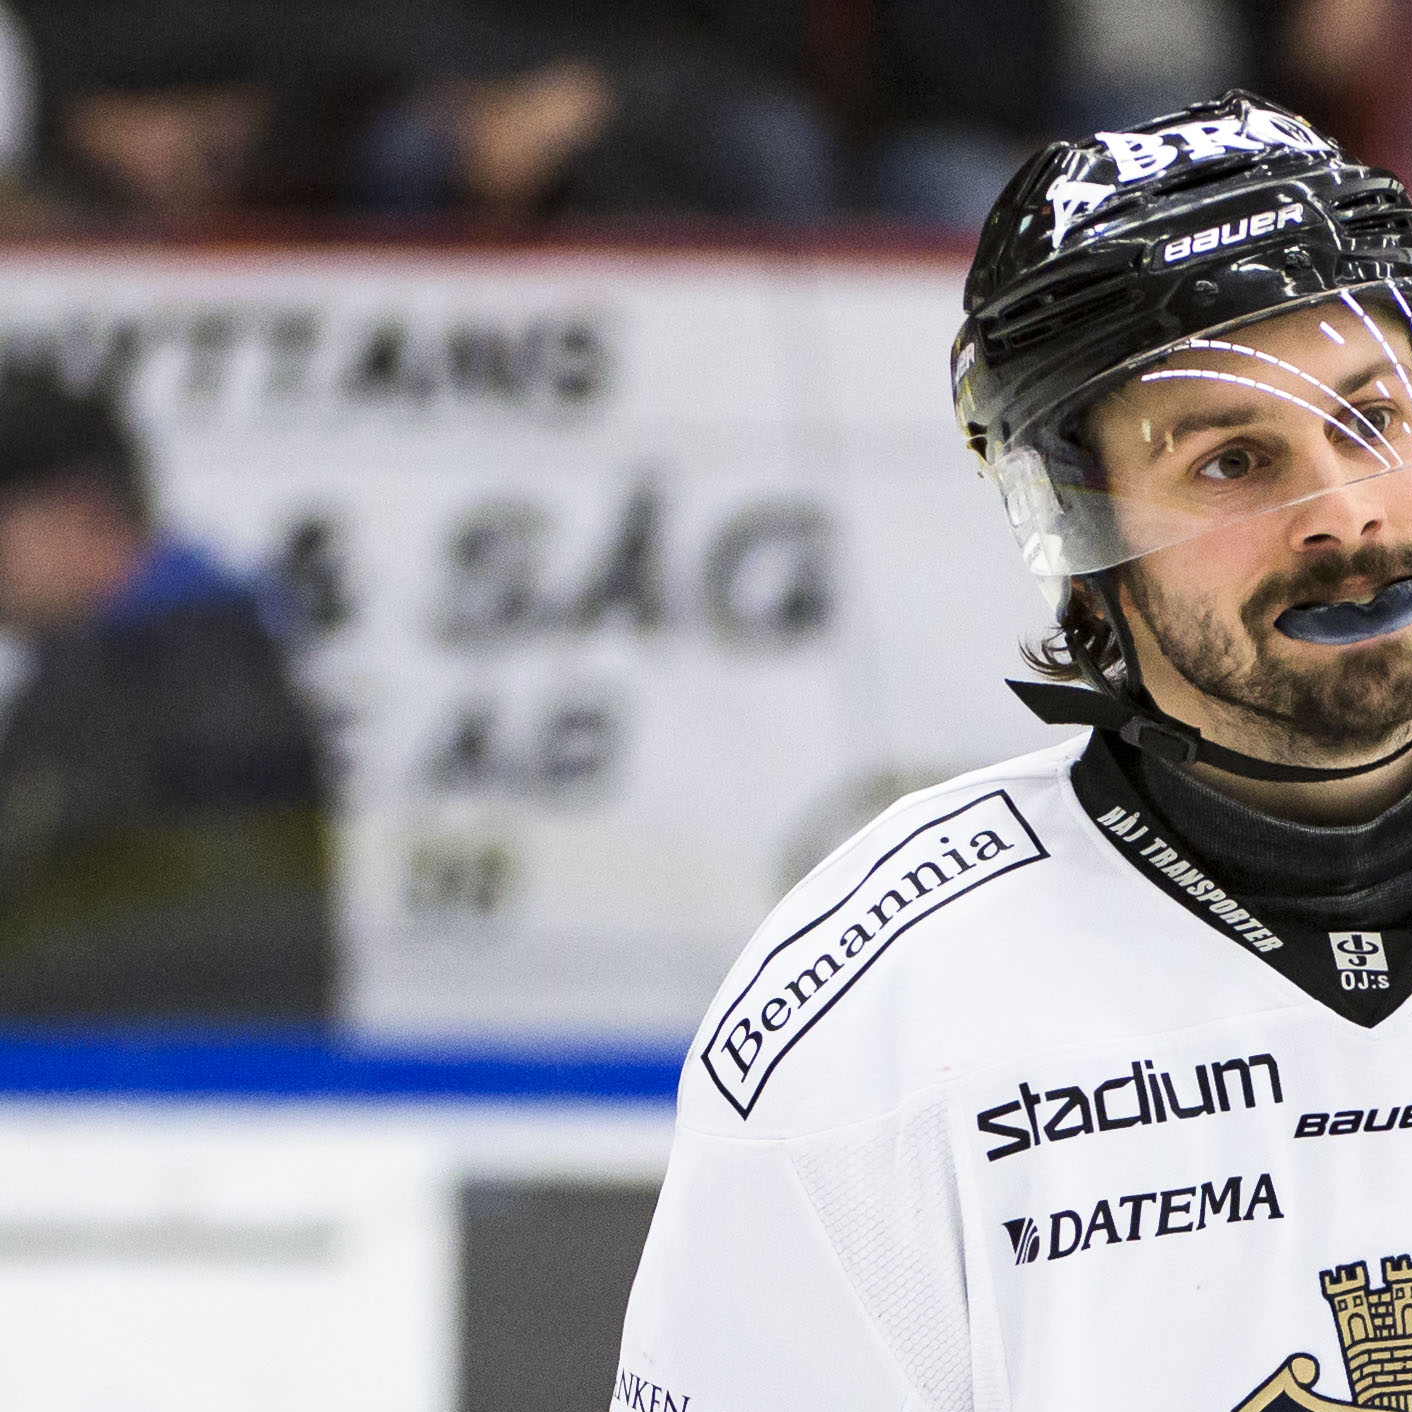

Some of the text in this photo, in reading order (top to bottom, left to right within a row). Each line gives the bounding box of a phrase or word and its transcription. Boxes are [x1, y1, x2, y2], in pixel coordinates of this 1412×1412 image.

[1140, 836, 1285, 953] TRANSPORTER
[720, 828, 1015, 1084] Bemannia
[976, 1052, 1284, 1163] stadium
[1047, 1172, 1285, 1262] DATEMA
